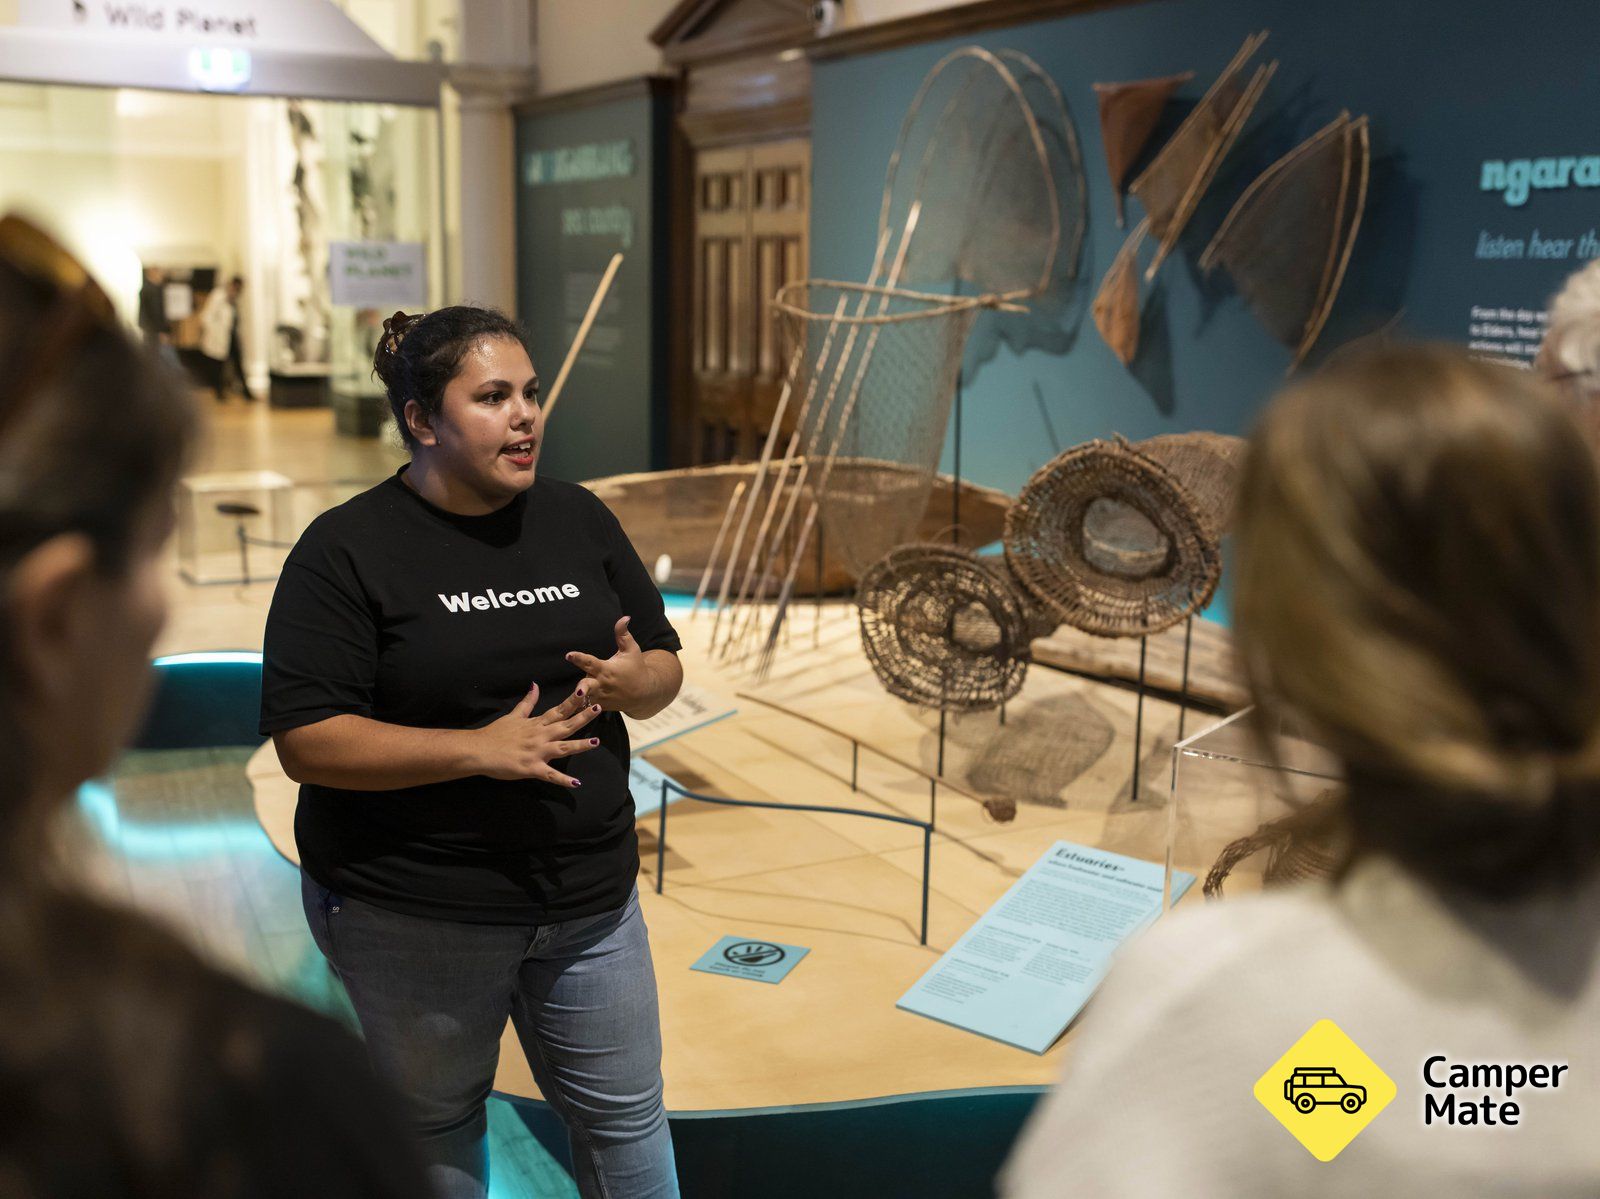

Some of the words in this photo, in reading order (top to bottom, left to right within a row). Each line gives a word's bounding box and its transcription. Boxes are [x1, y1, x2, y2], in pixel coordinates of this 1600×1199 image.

[104, 2, 164, 31] Wild
[176, 6, 257, 35] Planet
[1475, 228, 1525, 260] listen
[1527, 228, 1575, 260] hear
[437, 583, 580, 613] Welcome
